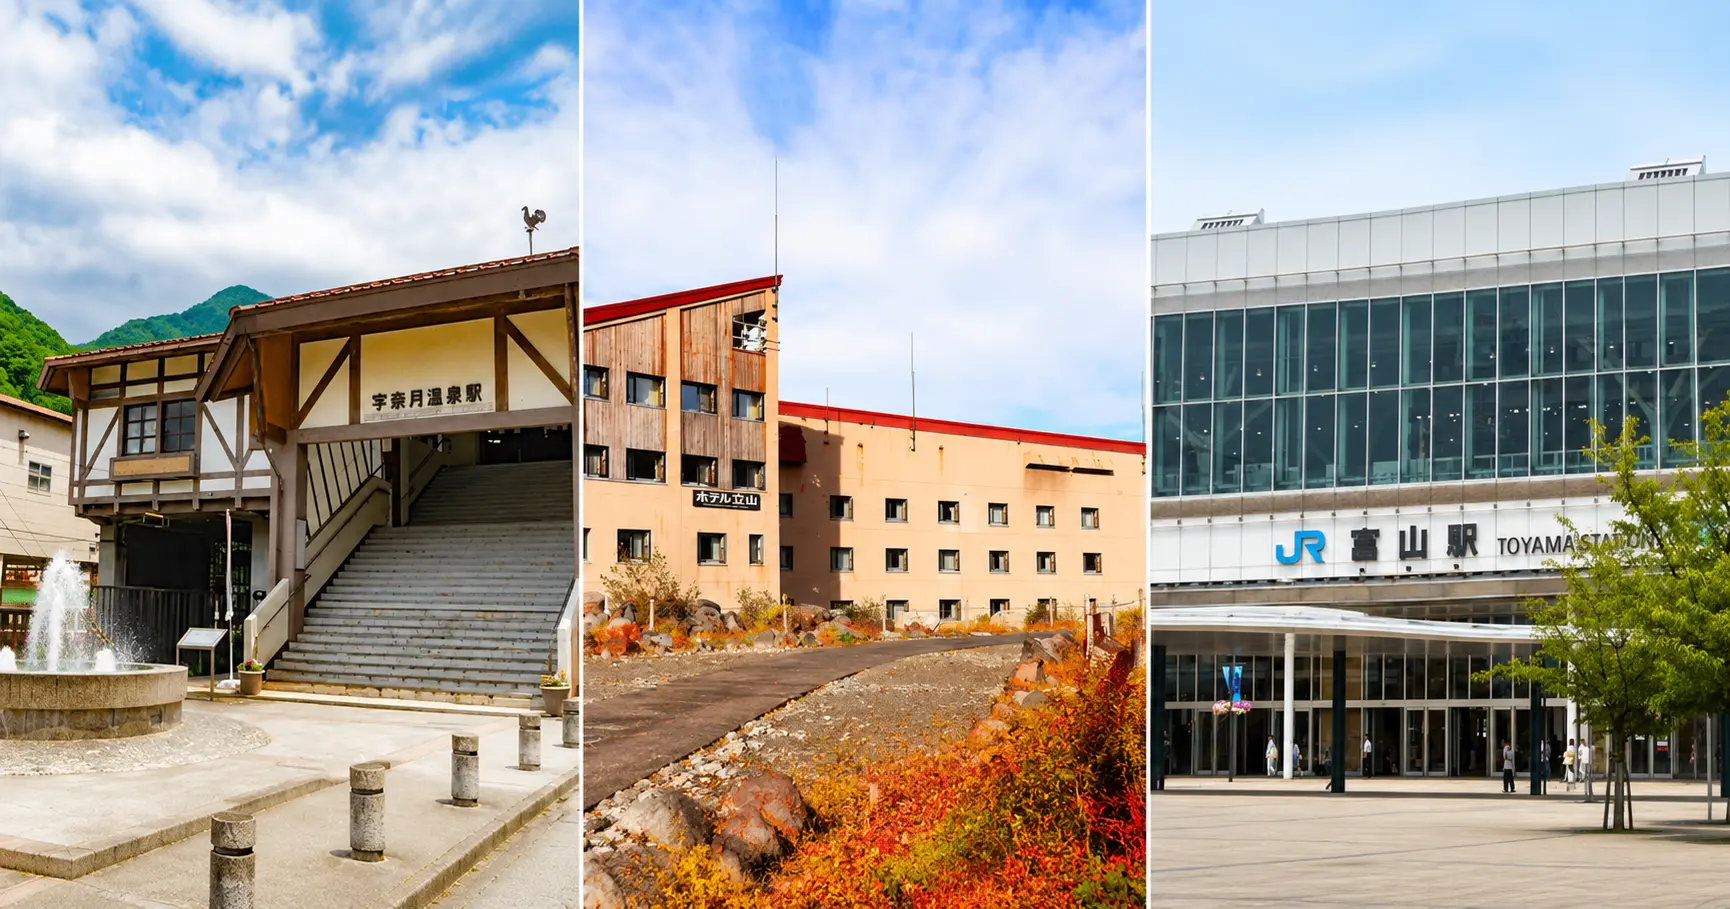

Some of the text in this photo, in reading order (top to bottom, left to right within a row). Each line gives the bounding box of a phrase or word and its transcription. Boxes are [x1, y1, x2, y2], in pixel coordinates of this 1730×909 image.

[372, 383, 482, 411] 宇奈月温泉駅
[696, 491, 757, 505] ホテル立山
[1275, 523, 1655, 565] JR 富山駅 TOYAMA STATON
